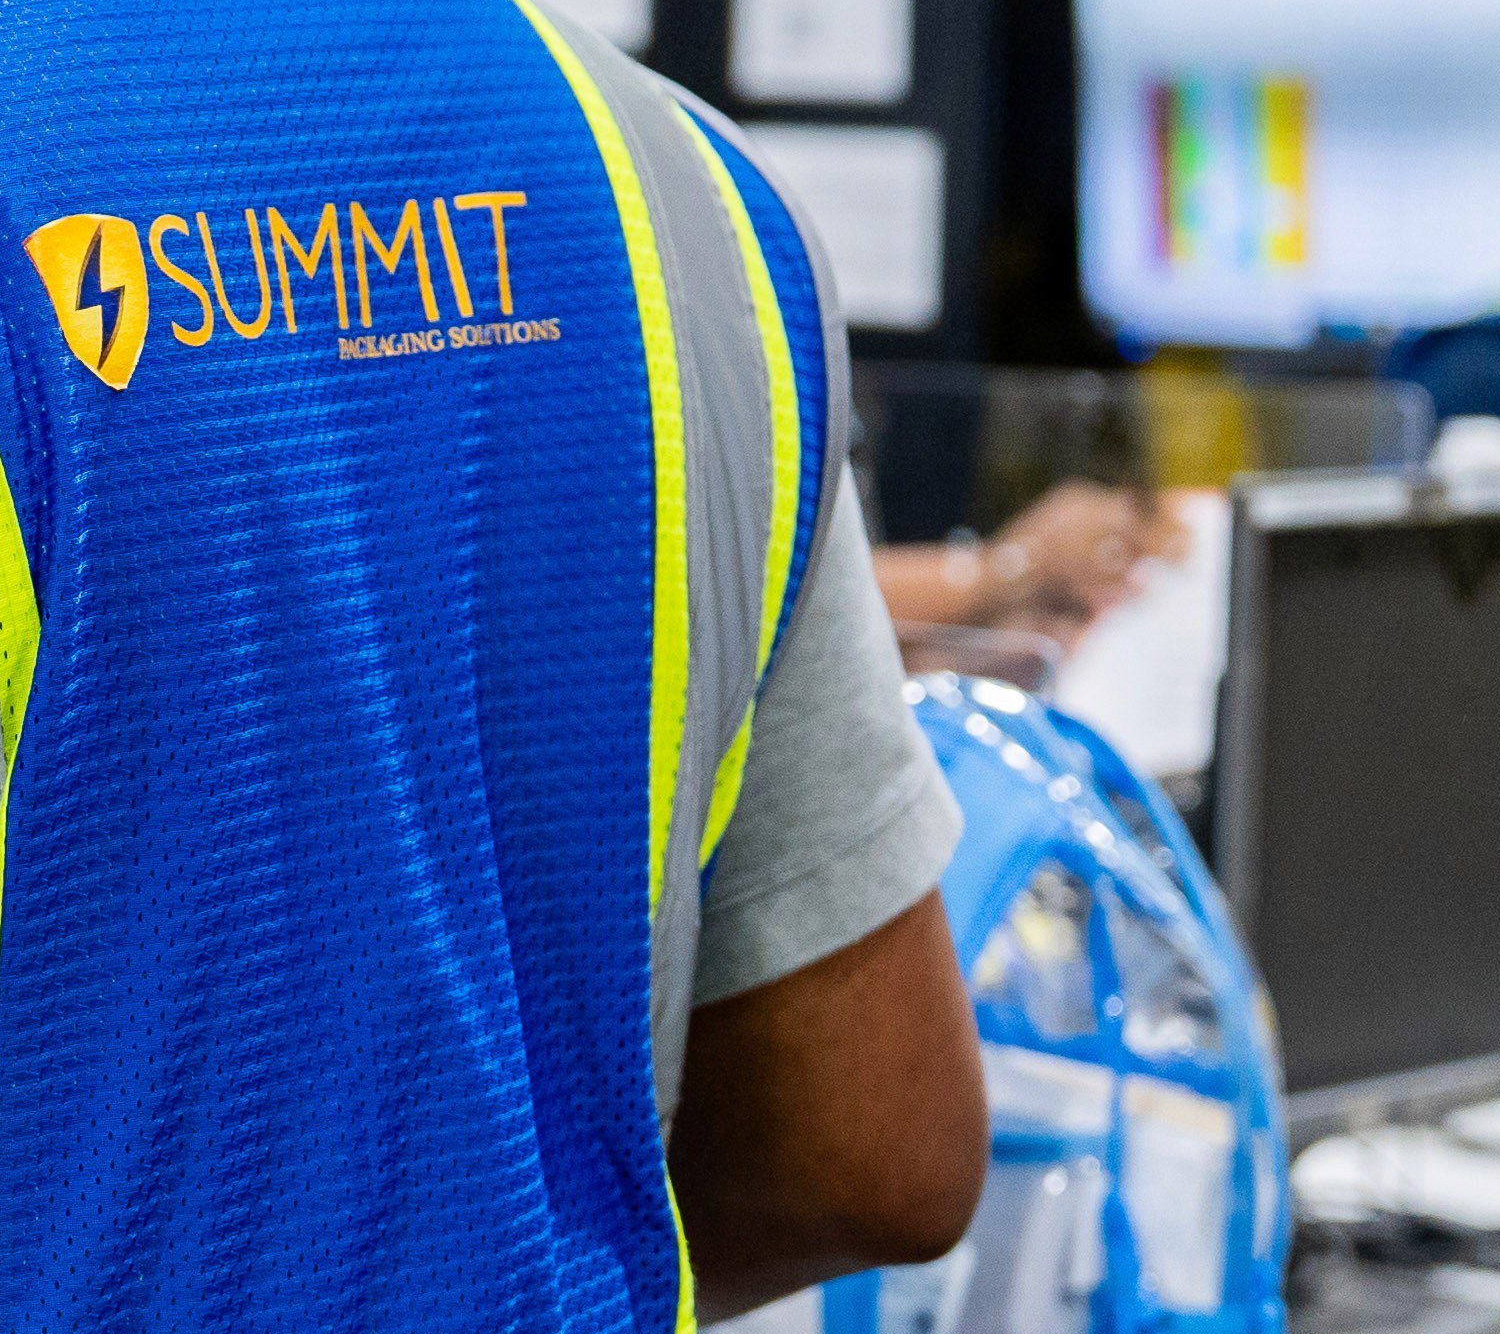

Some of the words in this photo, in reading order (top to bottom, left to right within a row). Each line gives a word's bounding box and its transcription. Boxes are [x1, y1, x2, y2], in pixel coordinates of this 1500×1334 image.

[149, 191, 527, 347] SUMMIT
[337, 328, 446, 361] PACKAGING
[446, 317, 562, 350] SOLUTIONS
